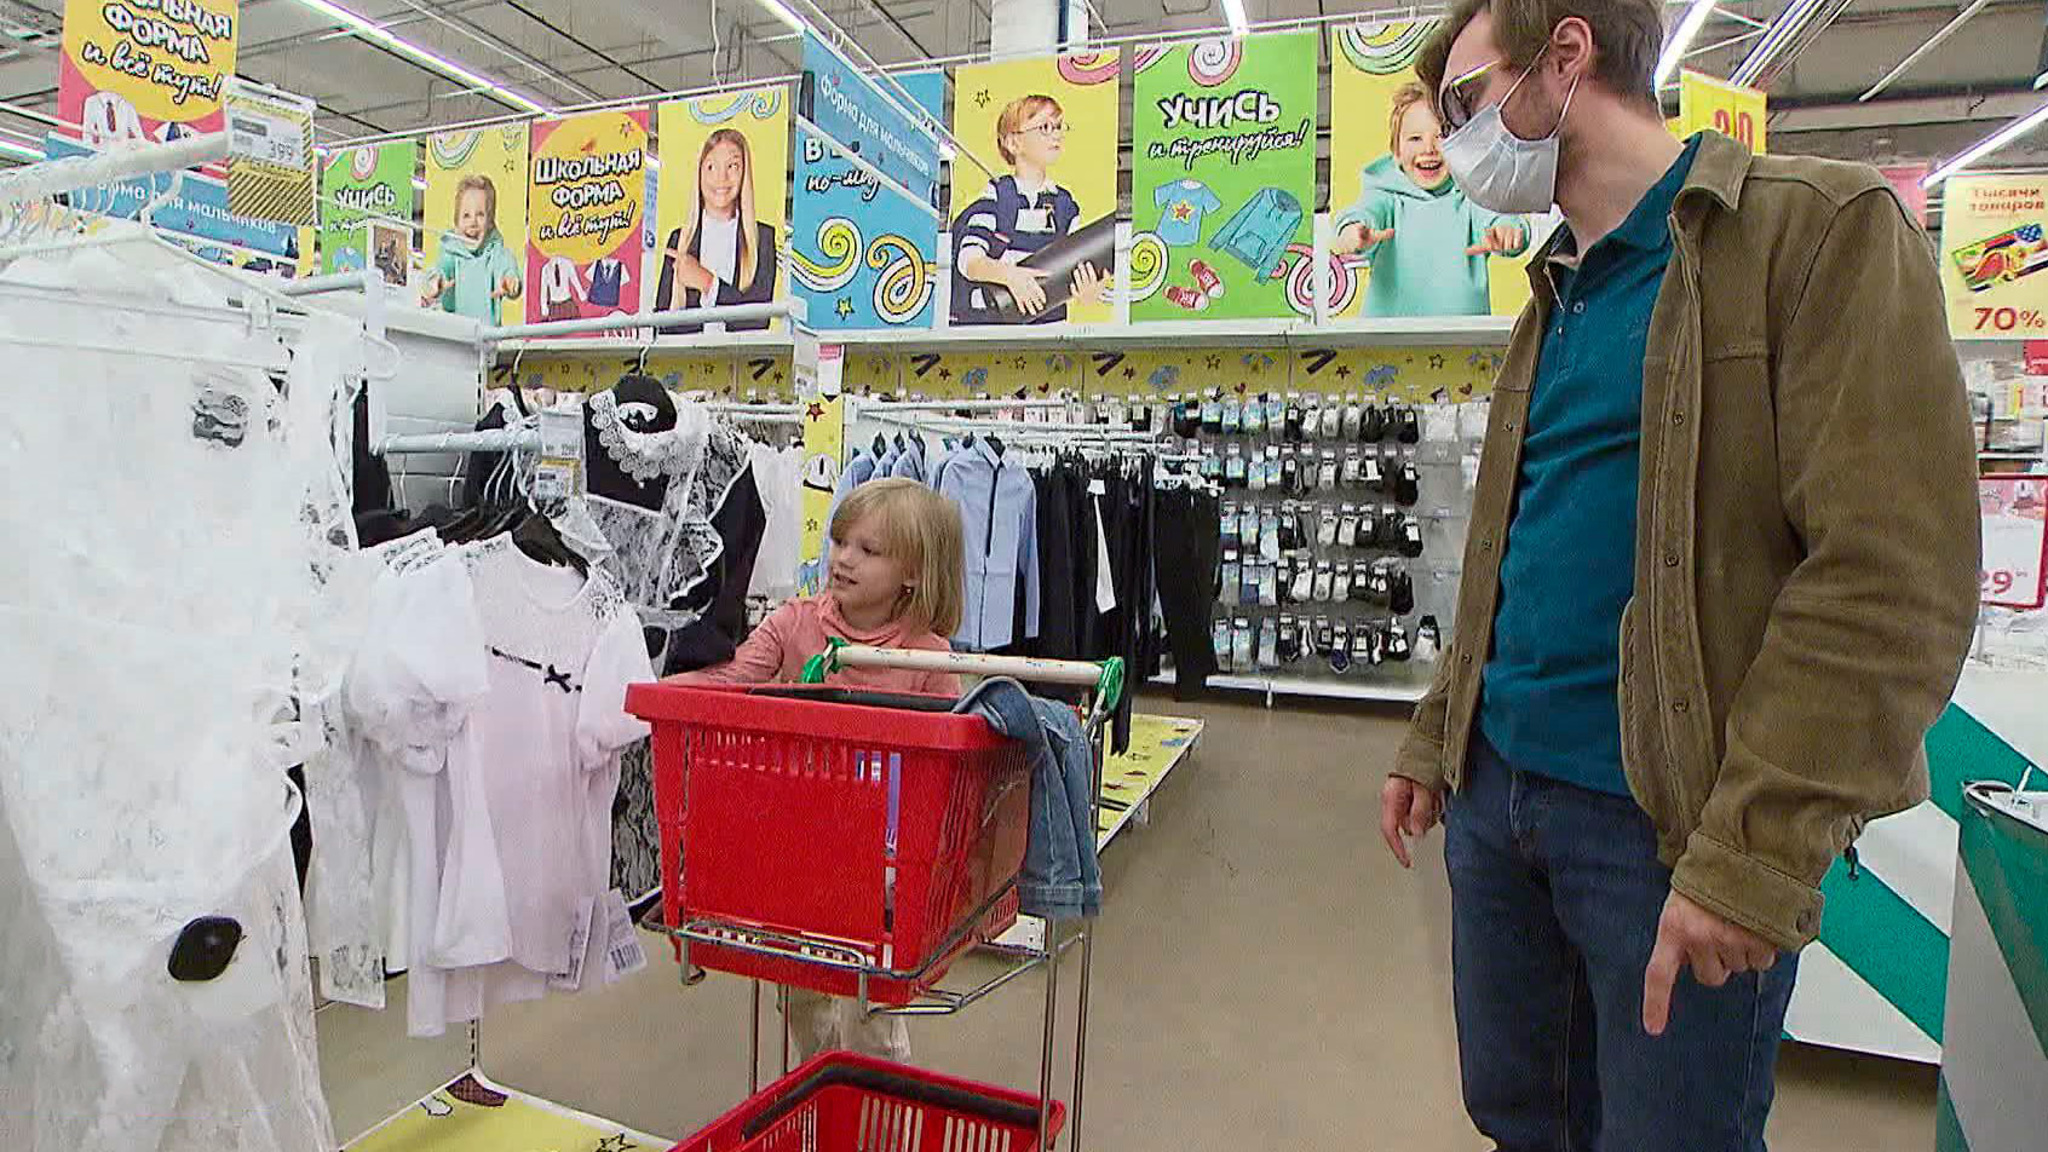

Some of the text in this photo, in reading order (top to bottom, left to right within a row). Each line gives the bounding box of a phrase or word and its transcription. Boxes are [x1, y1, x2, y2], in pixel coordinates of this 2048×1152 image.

[103, 3, 209, 63] ФОРМА
[82, 40, 223, 105] и всё тут!
[821, 73, 859, 122] Форма
[858, 111, 879, 139] для
[1157, 89, 1281, 128] УЧИСЬ
[1148, 118, 1310, 171] и тренируйся!
[535, 148, 642, 184] ШКОЛЬНАЯ
[334, 182, 396, 210] УЧИСЬ
[552, 180, 623, 209] ФОРМА
[540, 225, 554, 240] и
[557, 211, 583, 238] всё
[584, 200, 635, 245] тут!
[1974, 307, 2046, 330] 70%
